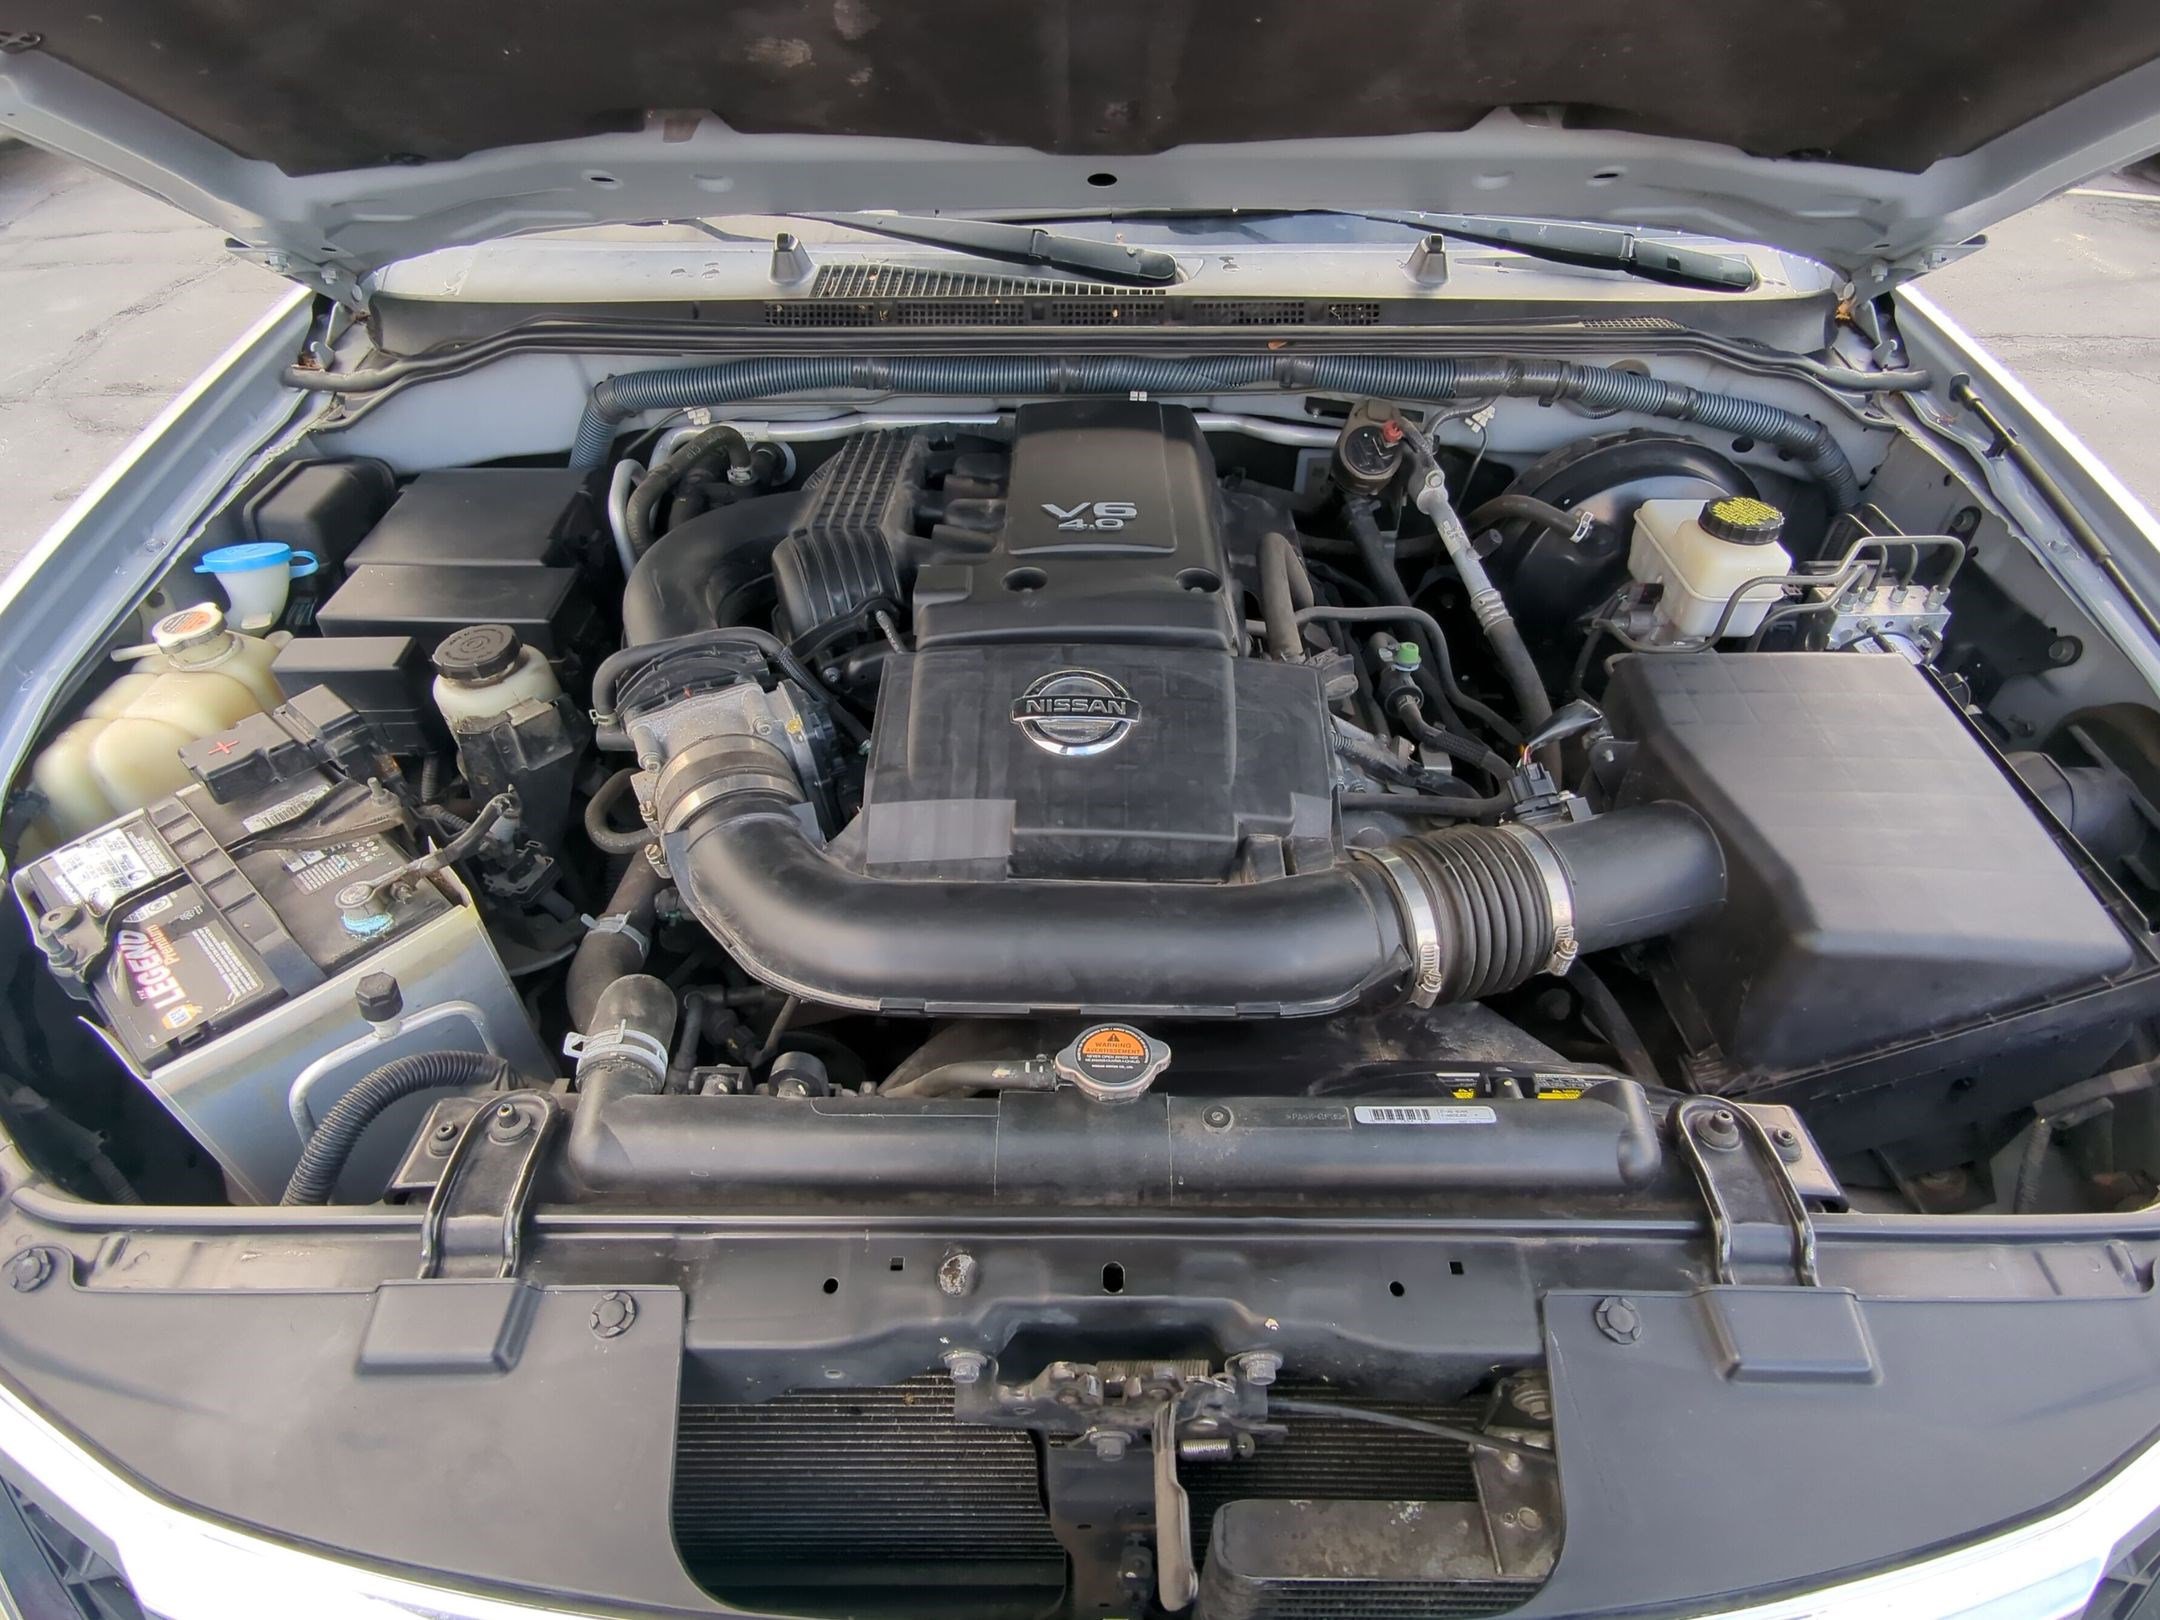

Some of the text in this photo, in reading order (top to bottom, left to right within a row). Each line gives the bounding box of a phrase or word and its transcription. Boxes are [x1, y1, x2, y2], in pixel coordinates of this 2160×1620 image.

[1041, 501, 1138, 520] V6
[1058, 518, 1125, 532] 4.0
[1025, 698, 1127, 716] NISSAN
[146, 923, 181, 967] Premium
[118, 930, 187, 1010] LEGEND
